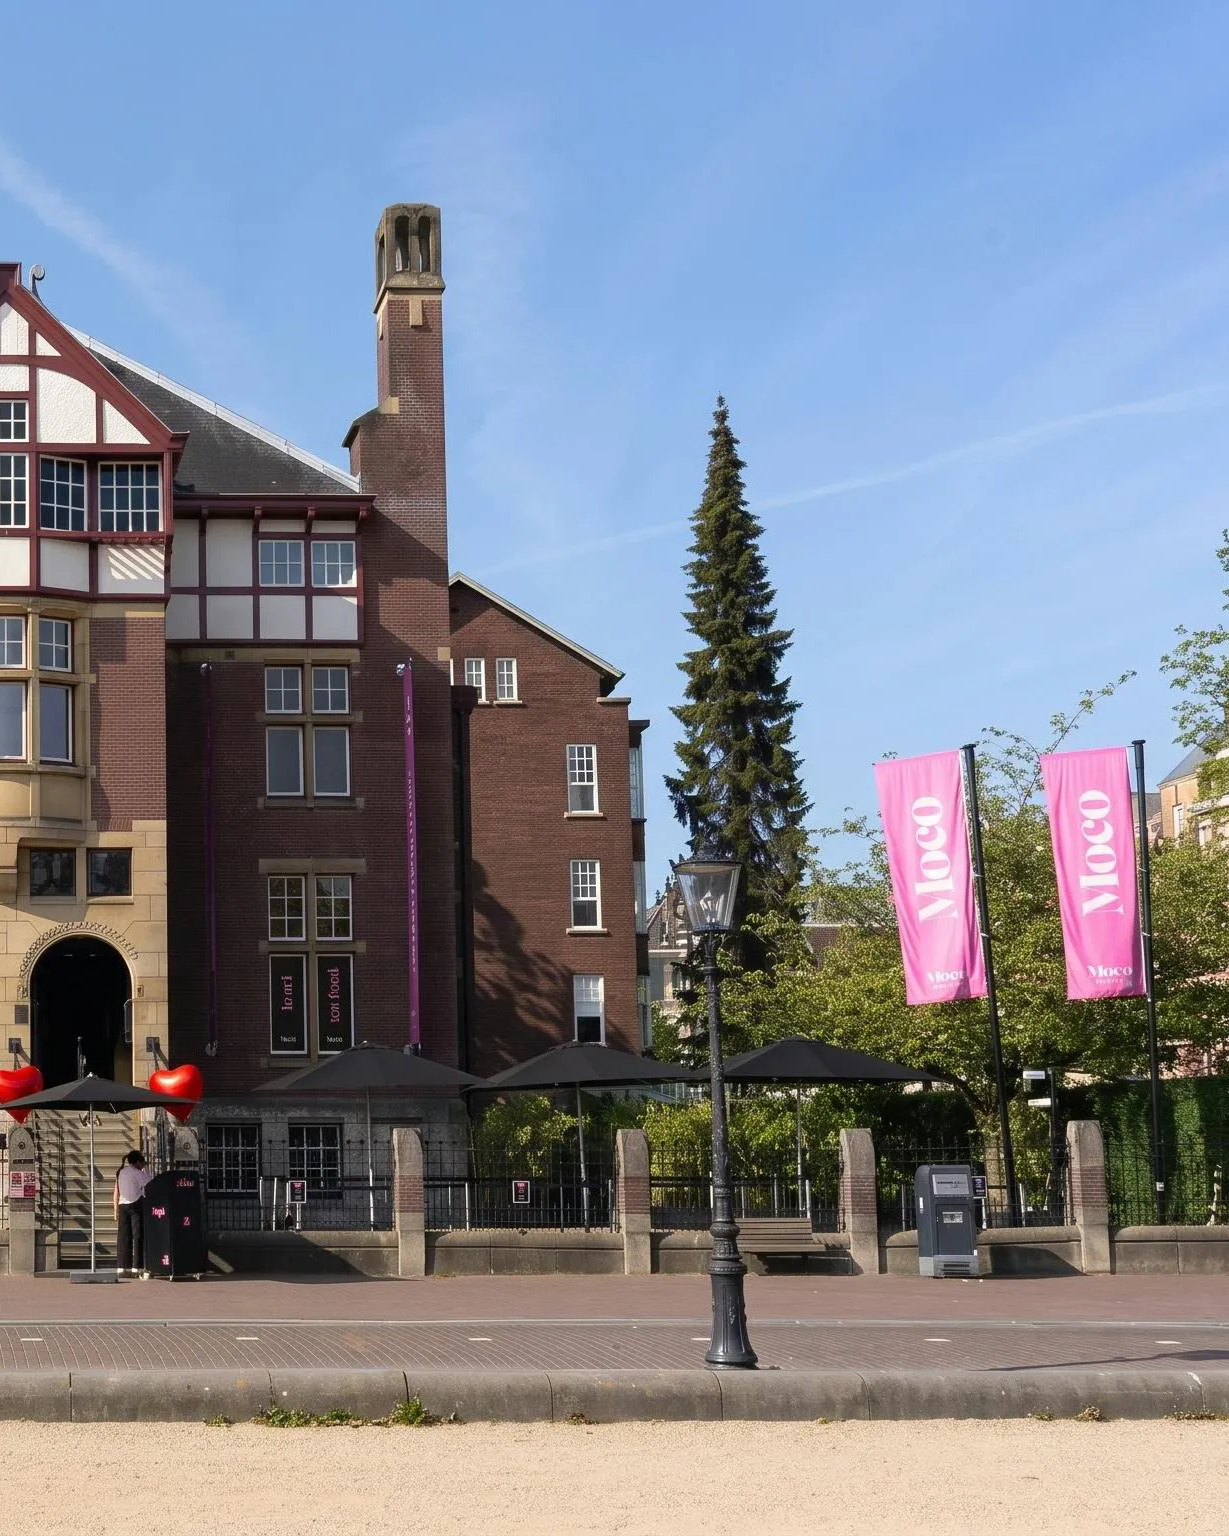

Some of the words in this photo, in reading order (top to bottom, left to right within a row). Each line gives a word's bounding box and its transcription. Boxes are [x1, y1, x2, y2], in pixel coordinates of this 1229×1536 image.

[911, 795, 959, 923] Moco
[1078, 789, 1125, 918] Moco
[1087, 964, 1133, 977] Moco
